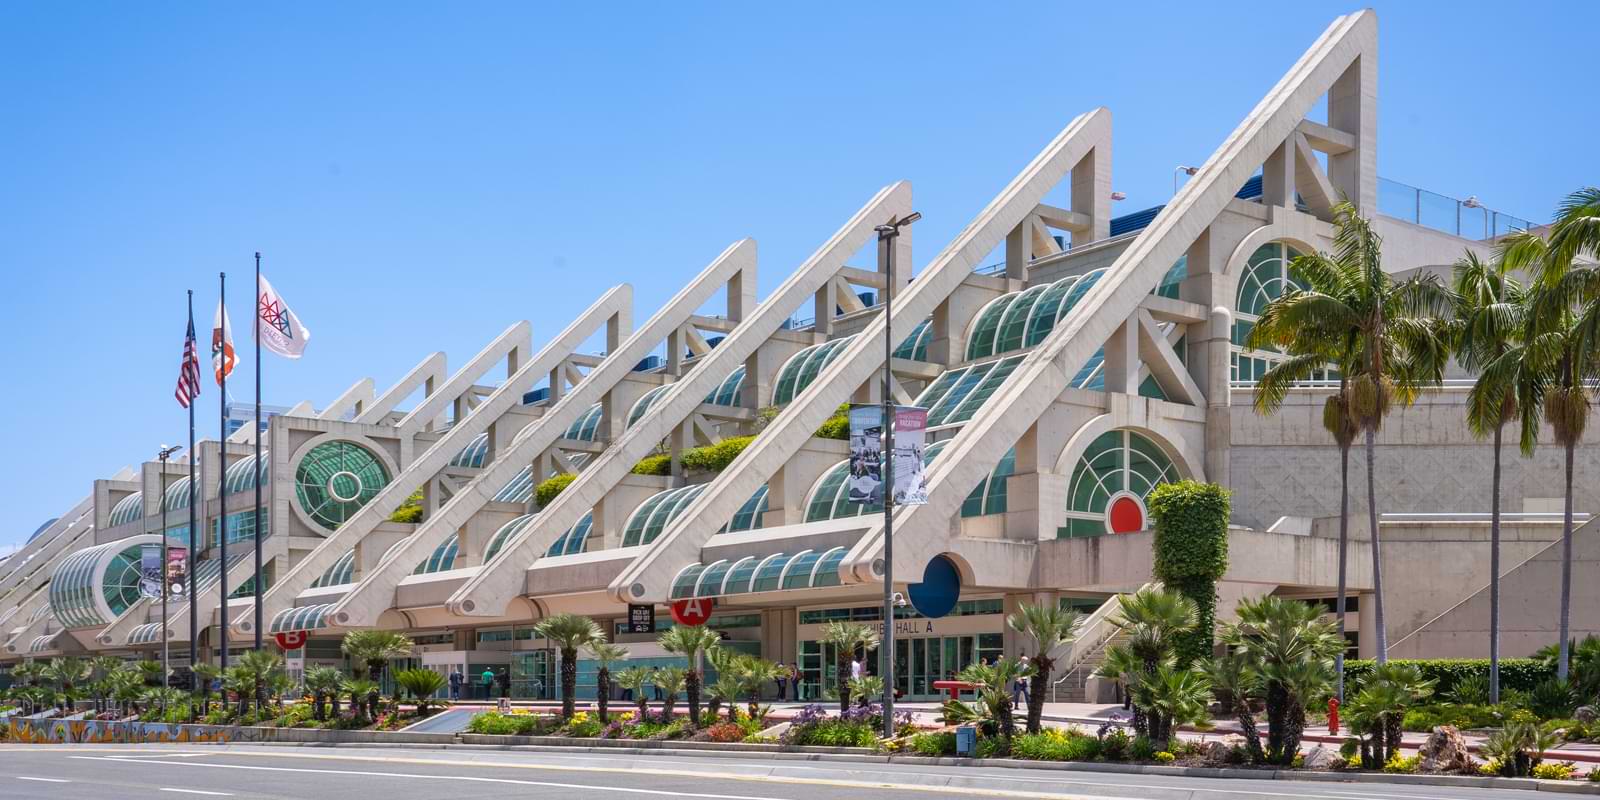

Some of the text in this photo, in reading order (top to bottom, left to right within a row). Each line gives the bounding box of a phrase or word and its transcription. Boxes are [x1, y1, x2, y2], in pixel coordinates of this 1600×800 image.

[683, 599, 704, 617] A
[895, 622, 919, 634] HALL
[926, 621, 933, 632] A
[285, 632, 300, 644] B
